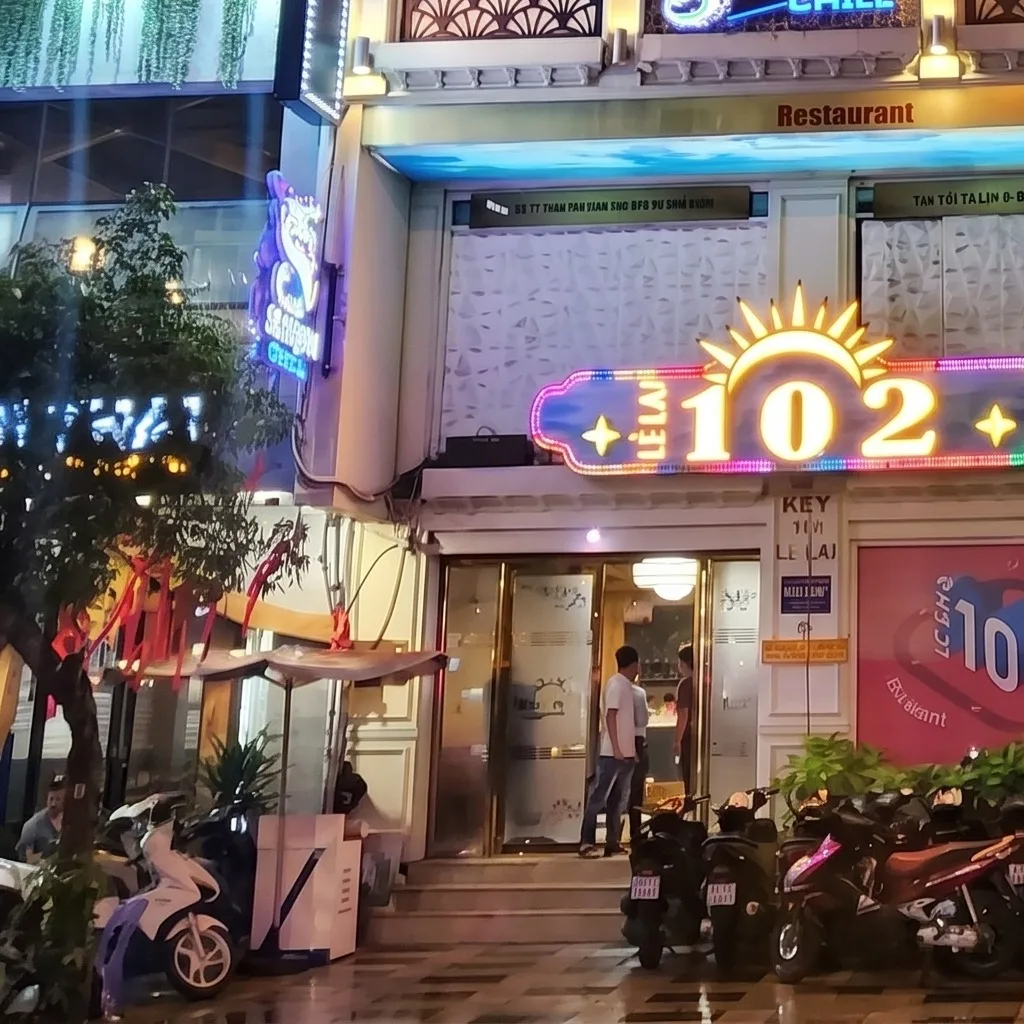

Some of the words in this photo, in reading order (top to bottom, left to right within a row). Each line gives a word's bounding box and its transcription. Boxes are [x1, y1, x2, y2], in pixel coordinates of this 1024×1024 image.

[777, 103, 914, 127] Restaurant
[680, 377, 937, 462] 102
[782, 495, 831, 513] KEY
